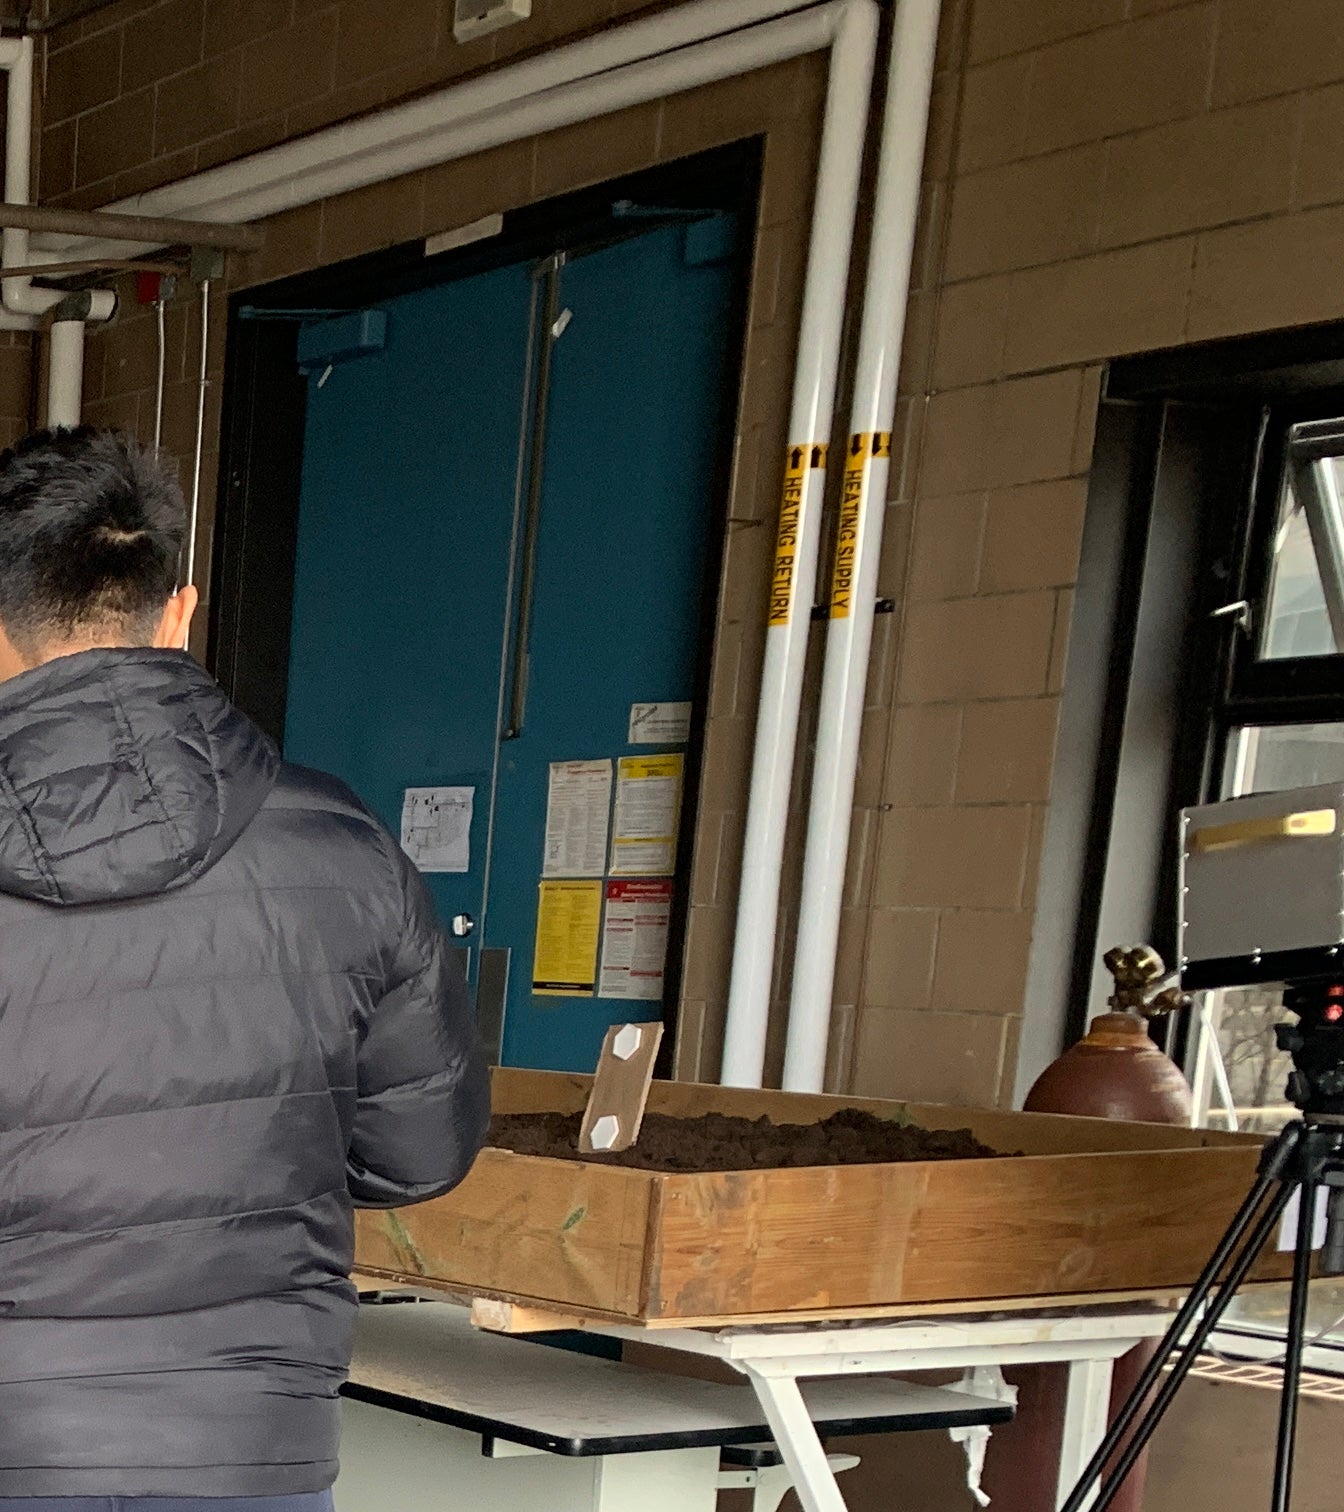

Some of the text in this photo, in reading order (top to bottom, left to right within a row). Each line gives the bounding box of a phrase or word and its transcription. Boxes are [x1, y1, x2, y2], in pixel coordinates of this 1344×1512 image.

[770, 477, 803, 620] HEATING RETURN
[833, 470, 861, 608] HEATING SUPPLY
